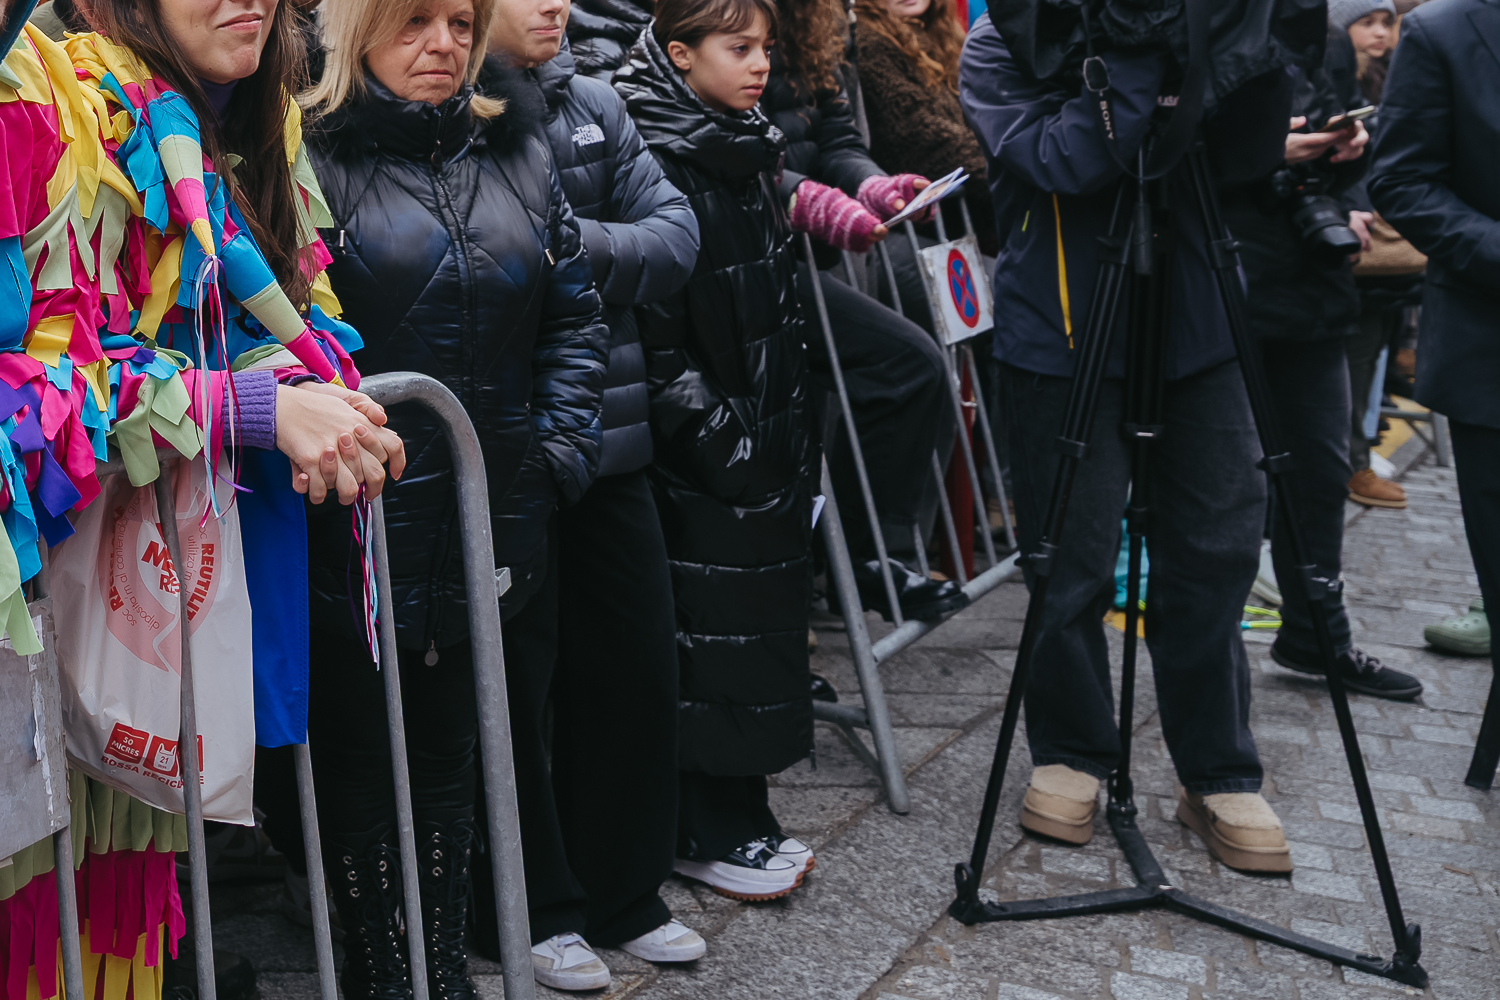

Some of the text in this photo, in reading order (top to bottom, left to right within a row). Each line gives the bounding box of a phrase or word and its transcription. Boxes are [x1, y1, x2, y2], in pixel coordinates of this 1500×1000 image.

[1099, 100, 1115, 140] SONY
[122, 608, 137, 627] soc
[111, 740, 141, 757] MICRES
[123, 735, 135, 746] 50
[101, 755, 140, 774] BOSSA
[159, 755, 170, 765] 21
